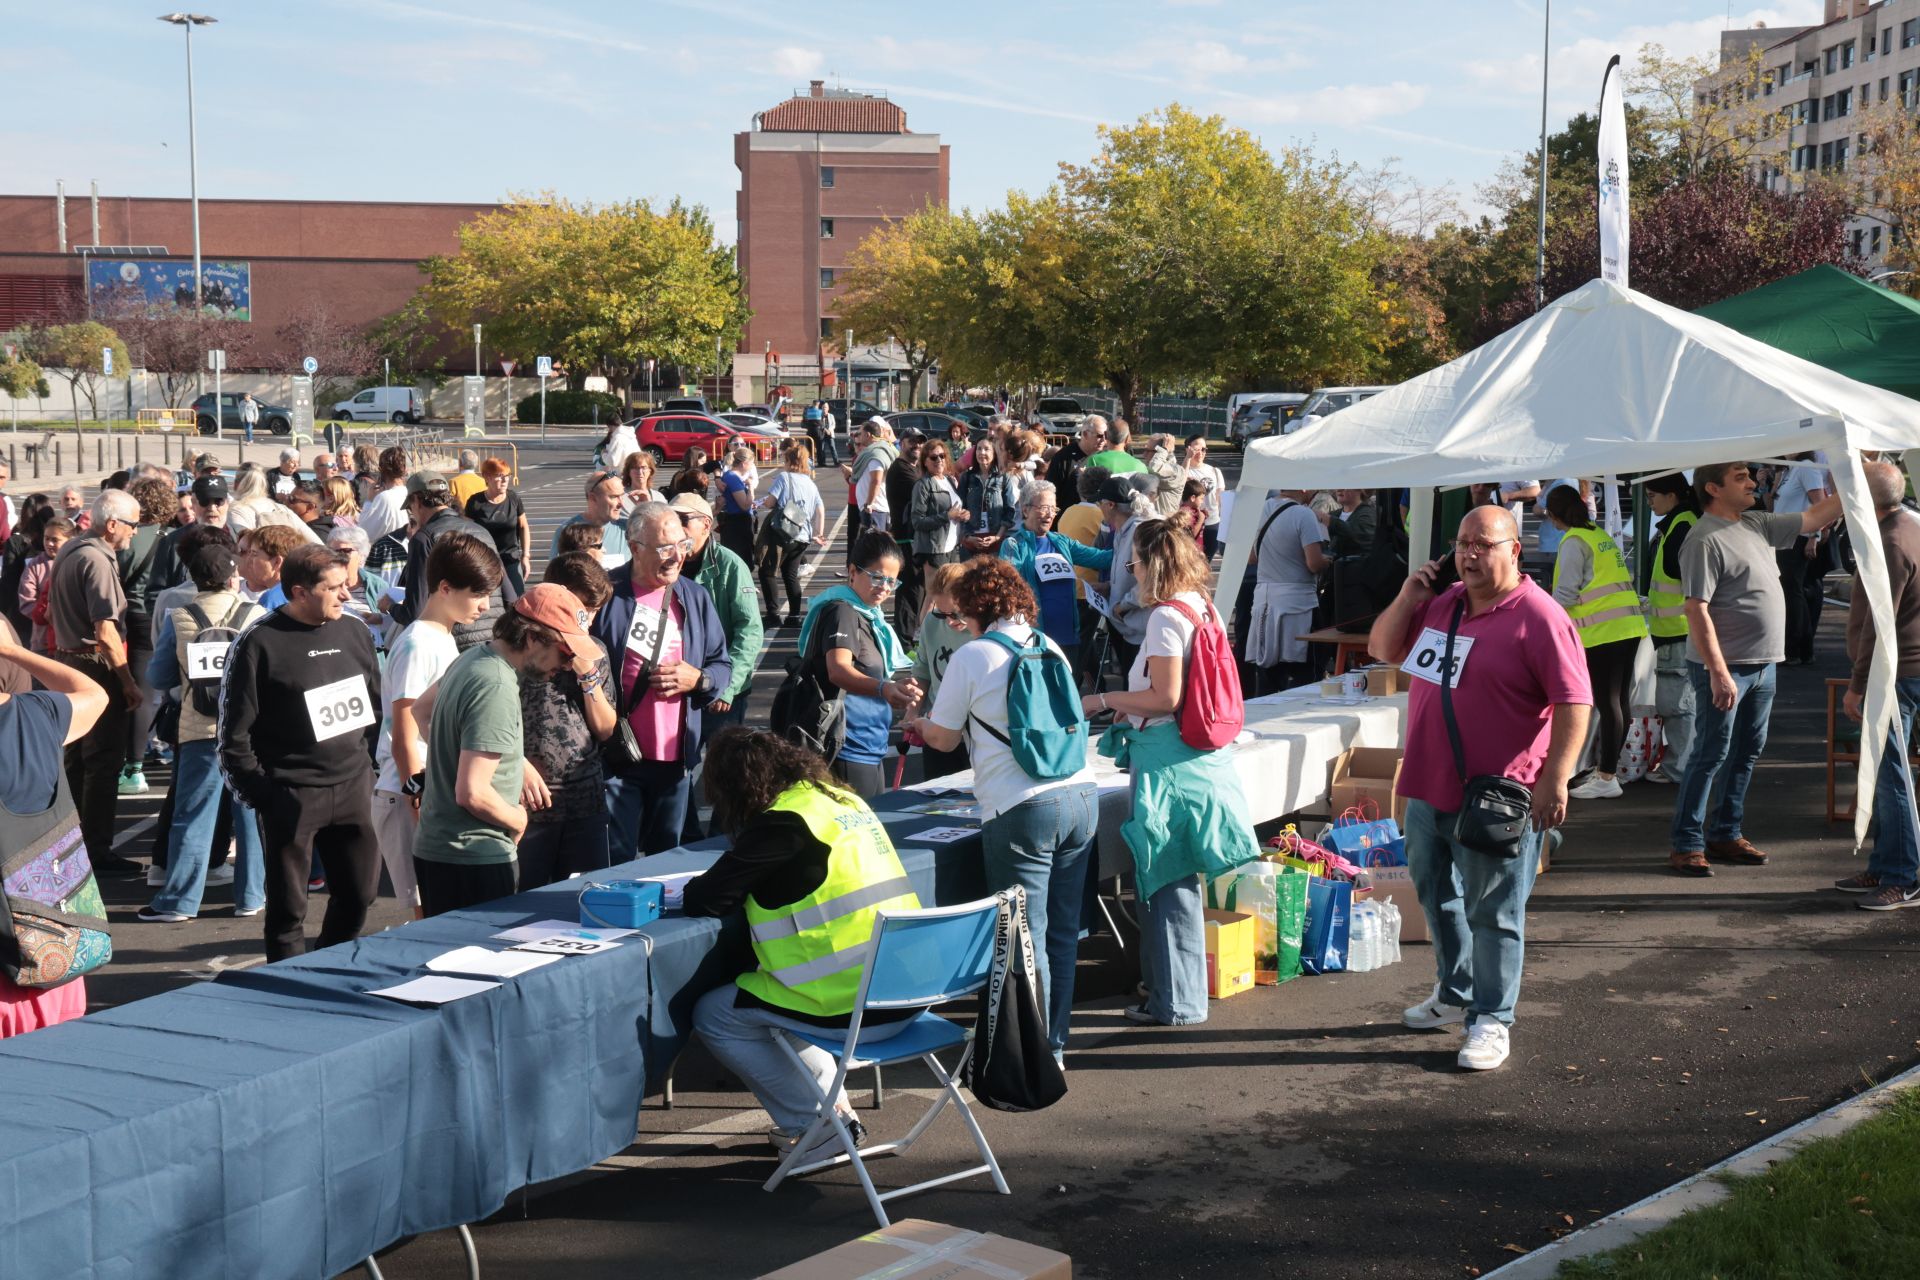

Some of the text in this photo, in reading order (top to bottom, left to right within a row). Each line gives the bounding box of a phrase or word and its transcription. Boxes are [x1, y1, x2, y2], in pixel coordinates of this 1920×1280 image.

[1041, 562, 1071, 575] 235
[308, 648, 341, 657] Champion
[198, 655, 224, 671] 16
[319, 696, 364, 727] 309
[990, 971, 1003, 1008] LOLA
